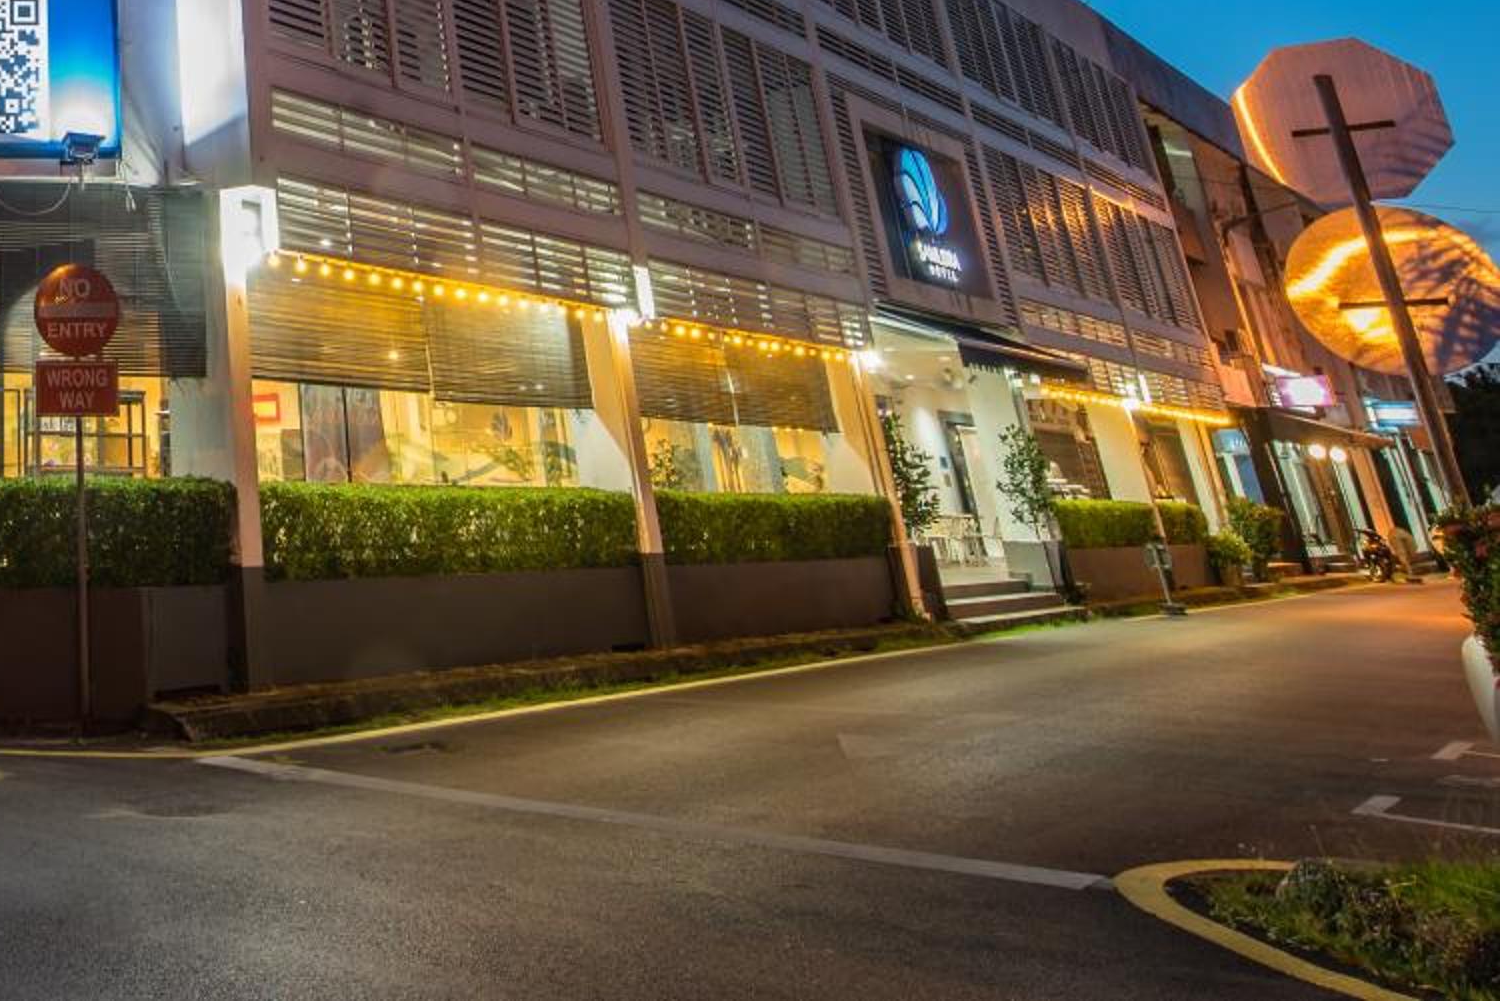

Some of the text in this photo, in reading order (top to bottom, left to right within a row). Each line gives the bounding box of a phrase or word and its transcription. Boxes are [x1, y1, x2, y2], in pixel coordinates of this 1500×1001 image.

[60, 279, 91, 298] NO
[47, 321, 108, 338] ENTRY
[47, 368, 108, 388] WRONG
[59, 390, 95, 409] WAY
